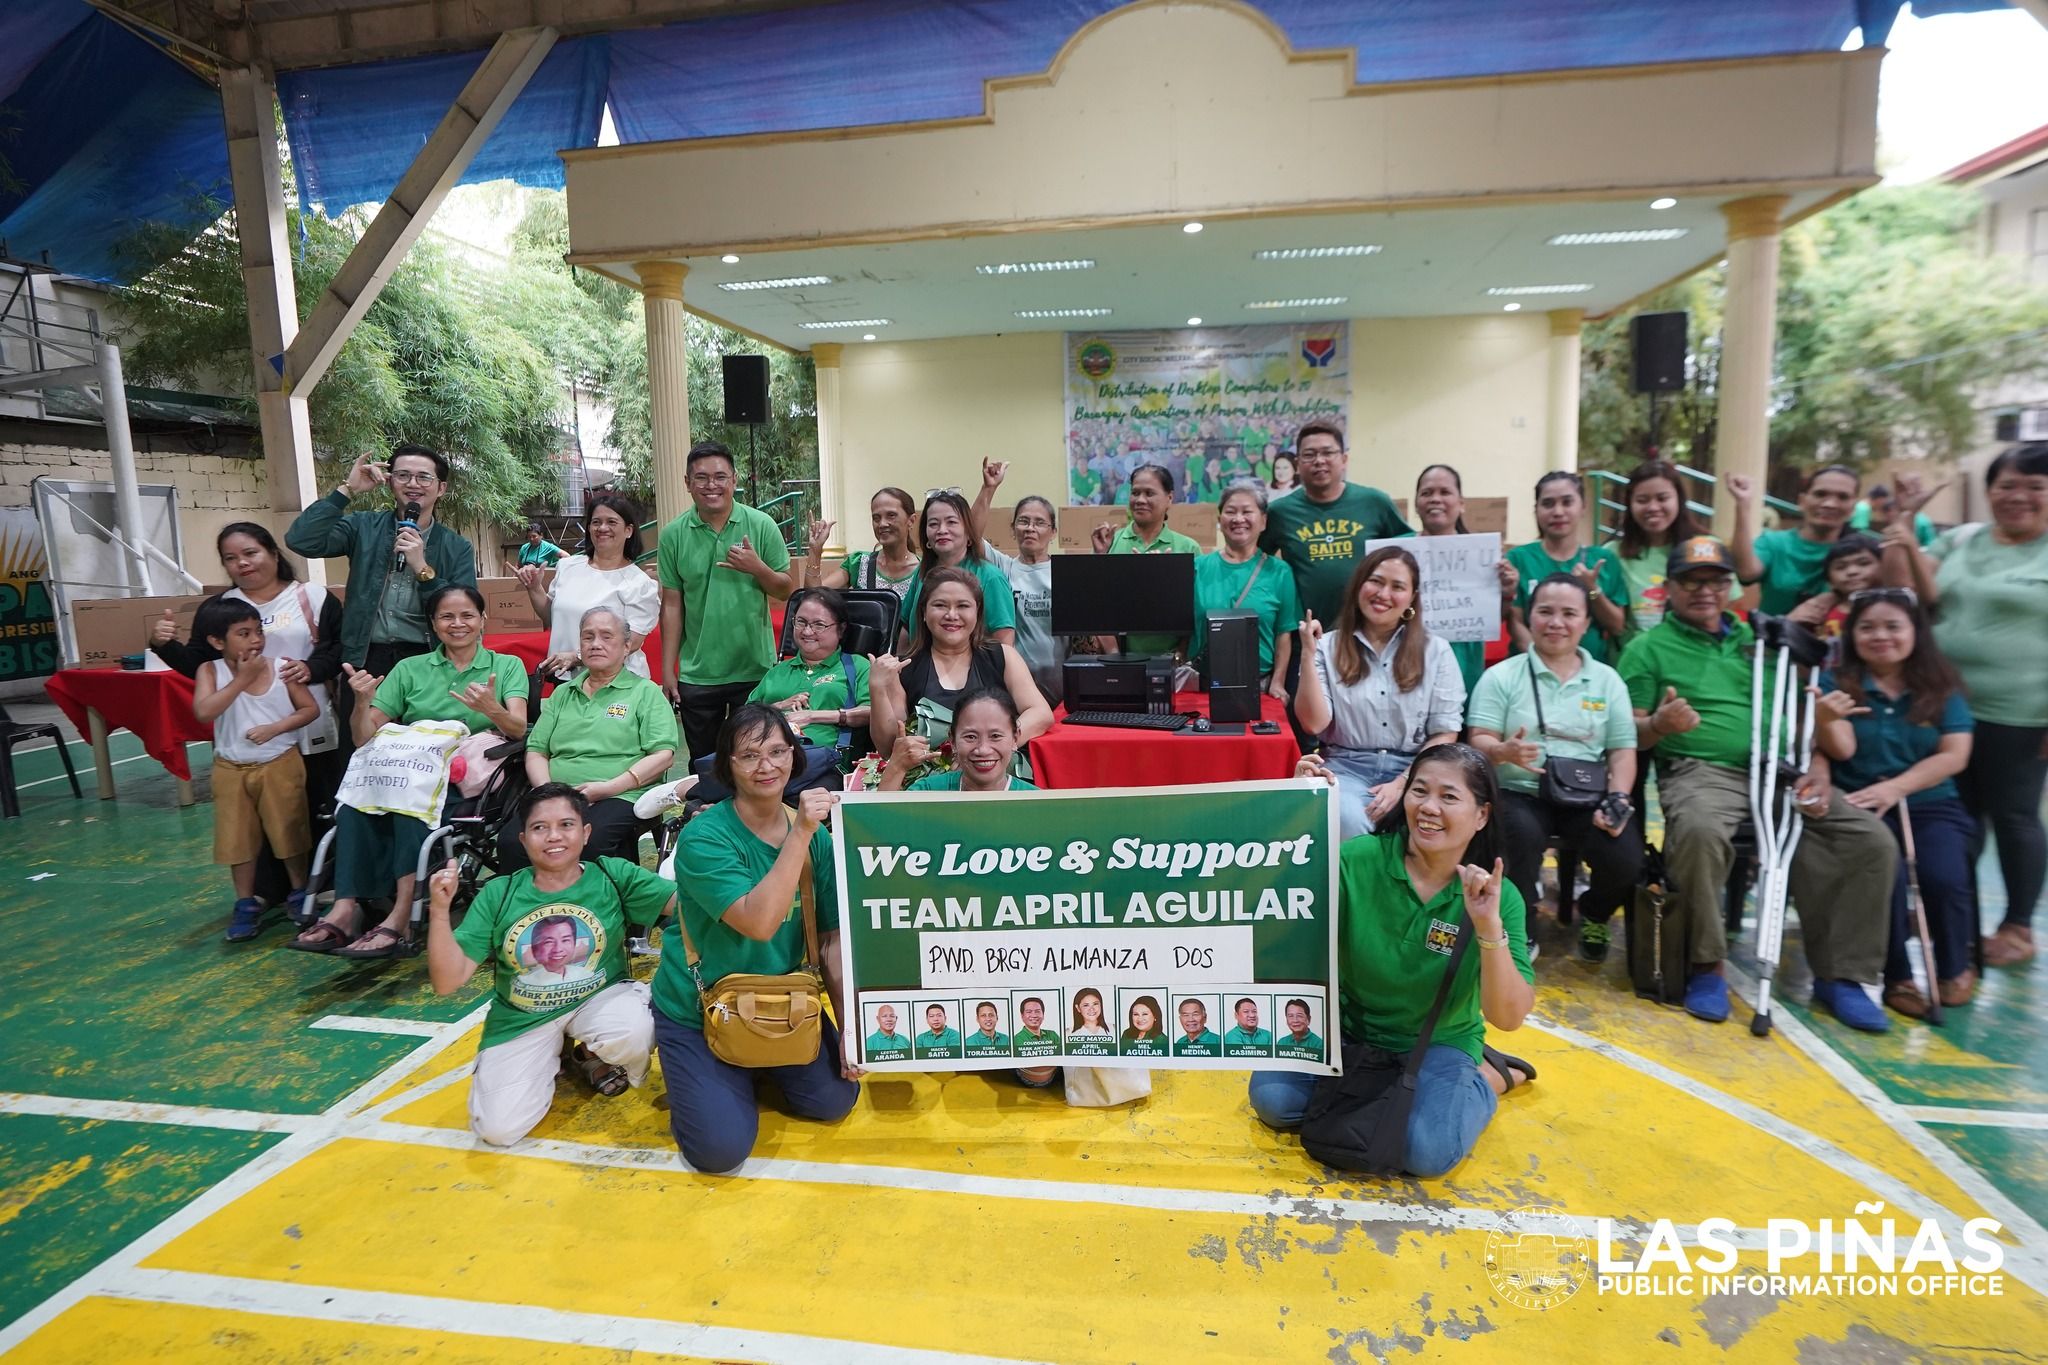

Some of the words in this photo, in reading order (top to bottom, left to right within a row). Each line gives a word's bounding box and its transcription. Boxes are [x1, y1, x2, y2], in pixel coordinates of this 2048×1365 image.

[1295, 519, 1364, 542] MACKY
[1308, 540, 1353, 555] SAITO
[9, 570, 40, 579] ANG
[85, 651, 108, 660] SA2
[369, 757, 434, 774] Federation
[857, 845, 931, 877] We
[938, 843, 1053, 876] Love
[1059, 841, 1100, 875] &
[1107, 834, 1314, 877] Support
[550, 907, 574, 915] LAS
[862, 896, 983, 930] TEAM
[992, 892, 1114, 927] APRIL
[1122, 887, 1315, 923] AGUILAR
[1043, 946, 1148, 972] ALMANZA
[1173, 946, 1214, 969] DOS
[513, 986, 543, 1000] MARK
[545, 982, 602, 1000] ANTHONY
[533, 995, 580, 1008] SANTOS
[874, 1053, 905, 1061] ARANDA
[1230, 1049, 1268, 1057] CASIMIRO
[1279, 1051, 1319, 1060] MARTINEZ
